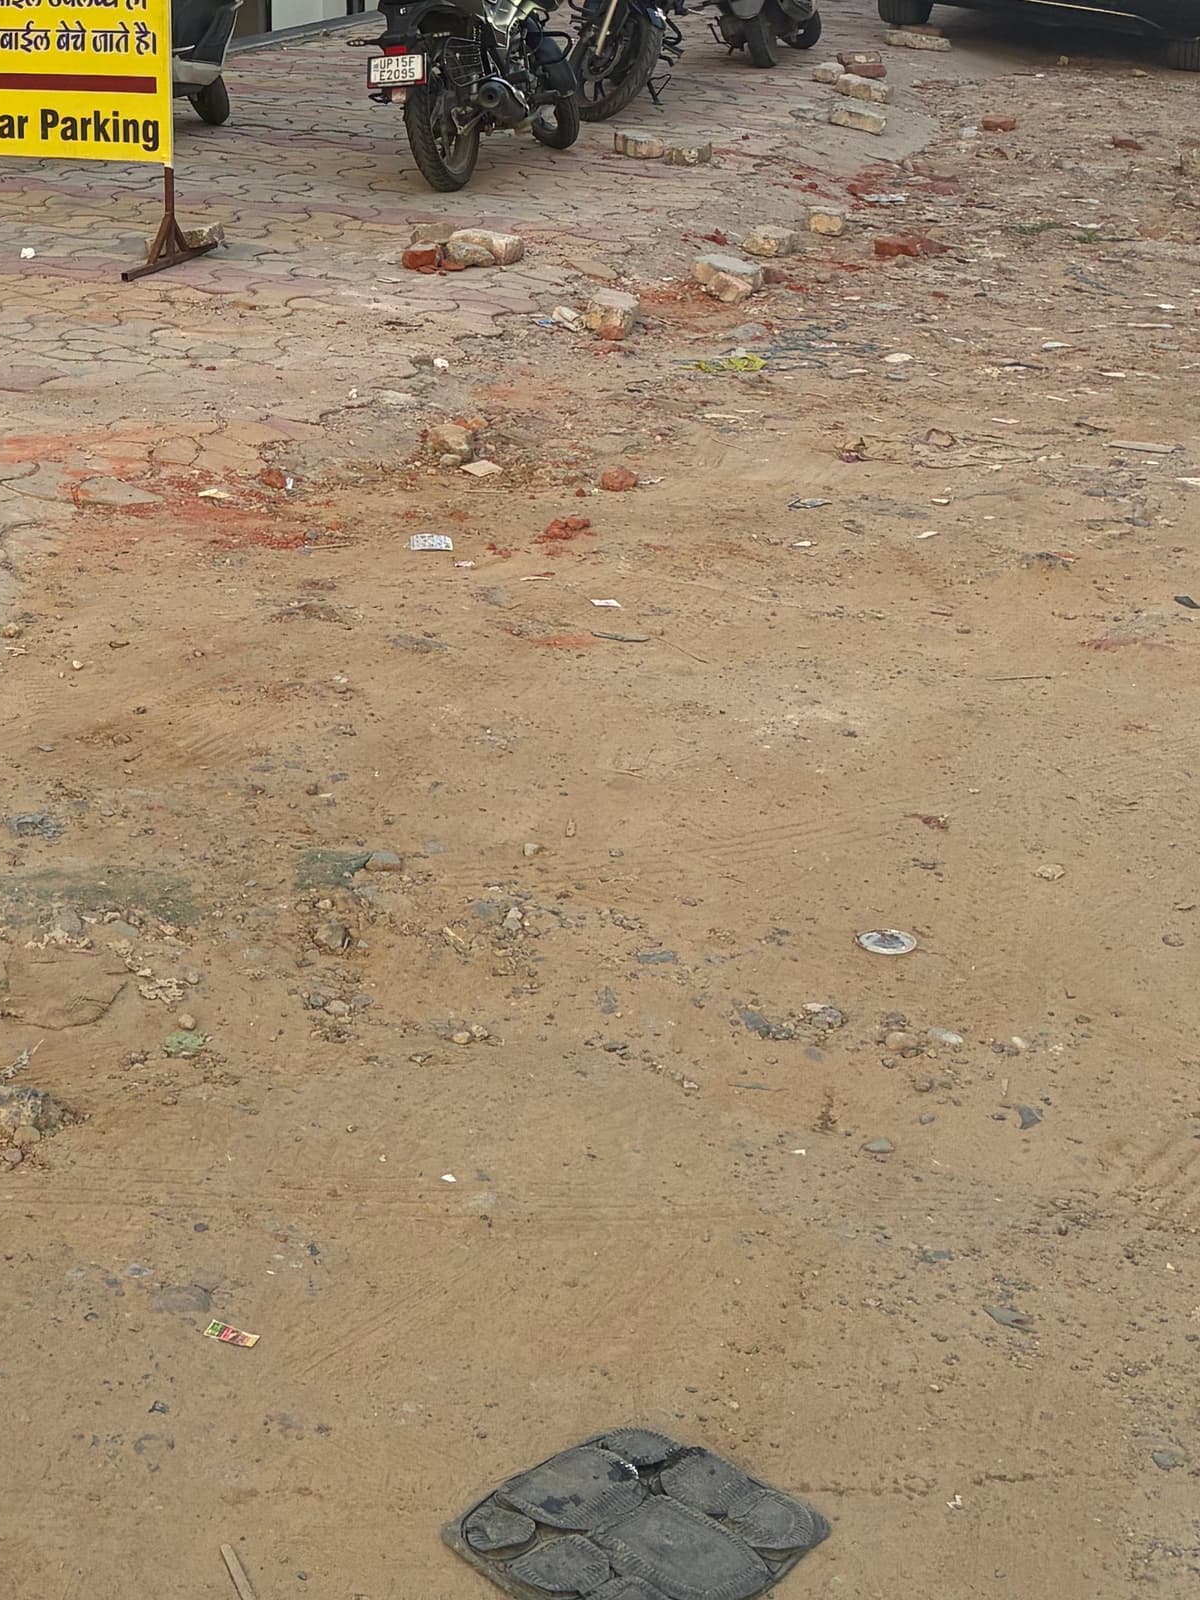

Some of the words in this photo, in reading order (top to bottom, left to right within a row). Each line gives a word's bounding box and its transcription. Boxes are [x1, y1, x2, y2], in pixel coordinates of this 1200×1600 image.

[56, 20, 87, 52] बेचे
[91, 21, 131, 54] जाते
[380, 68, 416, 81] E2095
[40, 108, 160, 153] Parking
